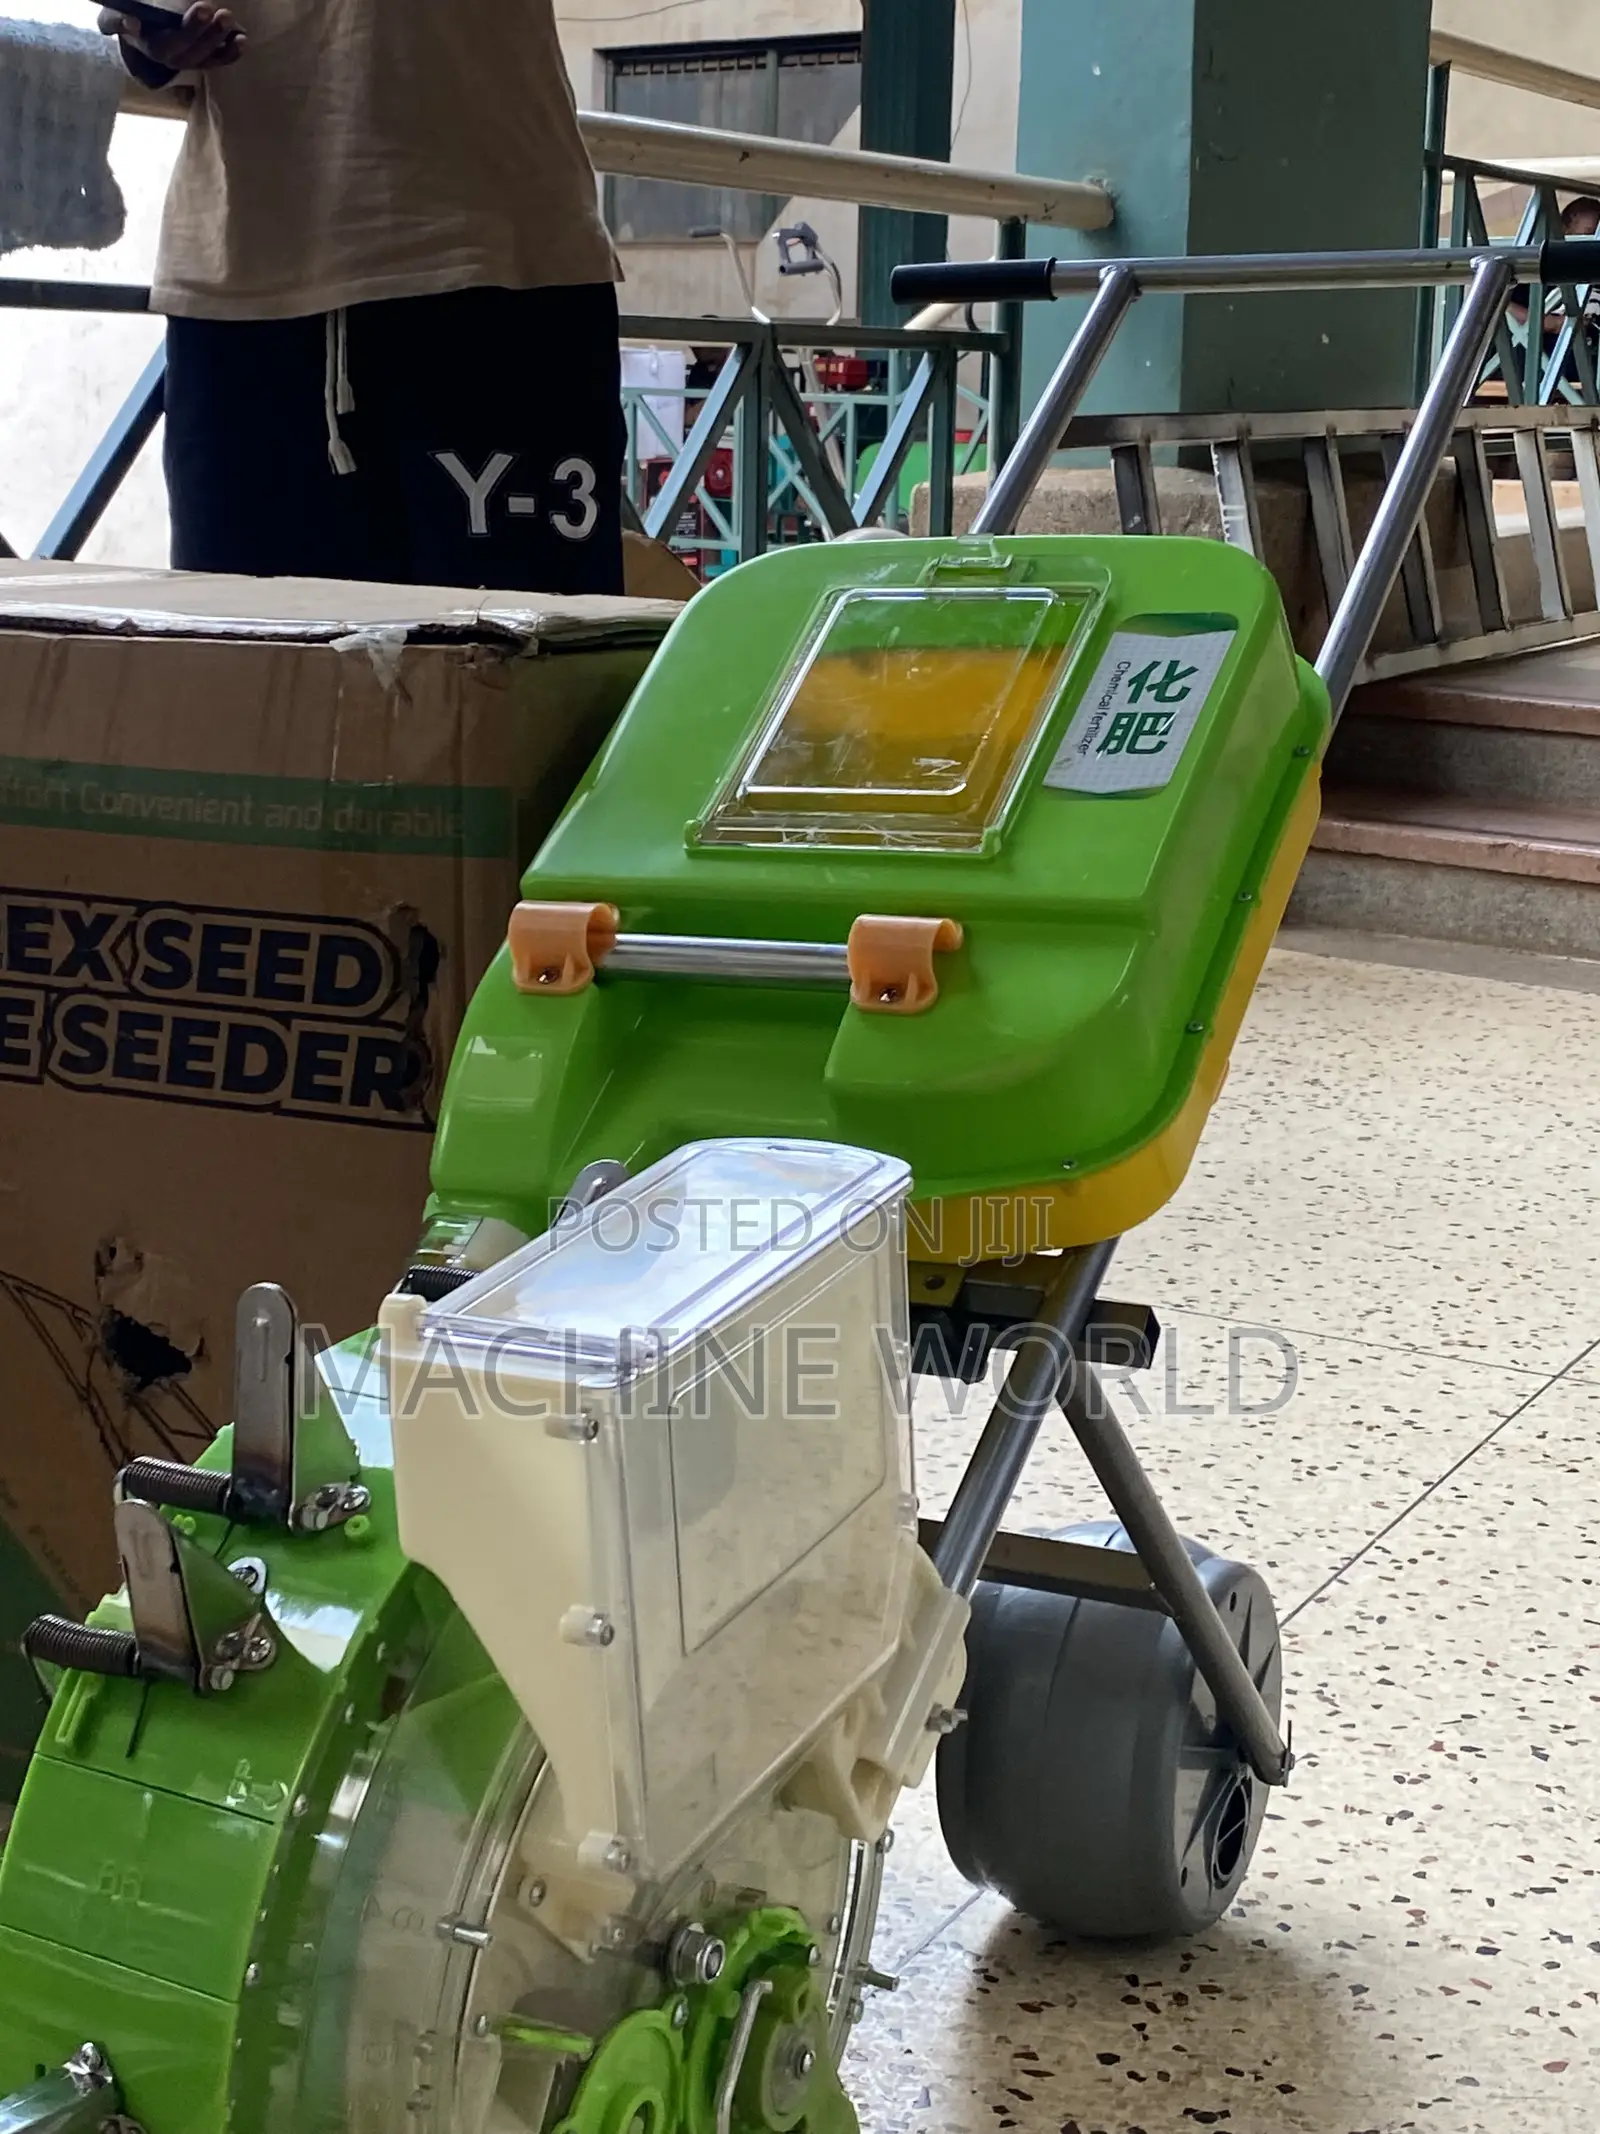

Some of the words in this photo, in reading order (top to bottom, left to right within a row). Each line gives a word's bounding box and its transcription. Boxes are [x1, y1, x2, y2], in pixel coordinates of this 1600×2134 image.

[431, 450, 600, 541] Y-3
[1096, 659, 1200, 756] 化肥
[1097, 661, 1132, 711] Chemical
[1076, 711, 1108, 756] fertilizer
[80, 780, 253, 828] Convenient
[264, 799, 323, 832] and
[0, 904, 119, 982] EX
[140, 917, 383, 1008] SEED
[58, 1002, 415, 1112] SEEDER
